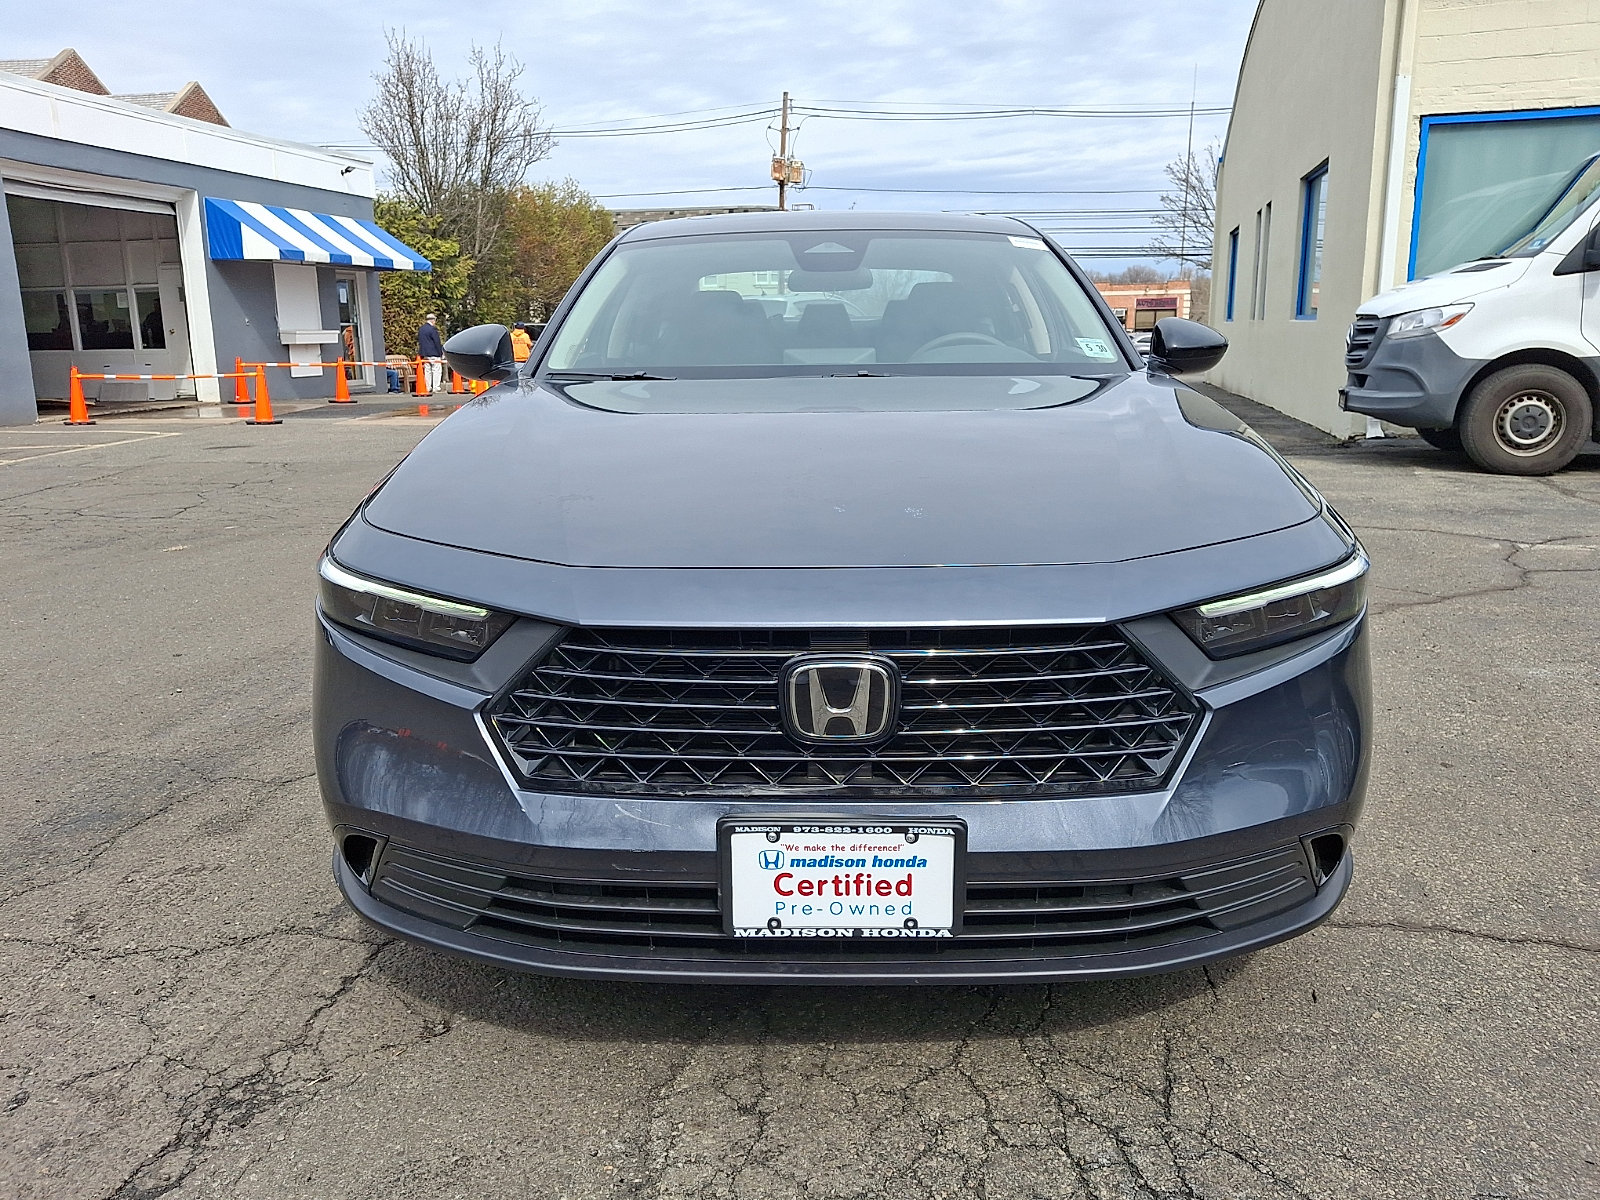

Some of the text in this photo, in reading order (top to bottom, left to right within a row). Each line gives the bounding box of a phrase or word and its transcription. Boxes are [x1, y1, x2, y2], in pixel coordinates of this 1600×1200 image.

[1085, 343, 1108, 353] 5 30
[792, 826, 893, 834] 973-822-1600
[908, 827, 956, 835] HONDA
[780, 843, 905, 852] "We make the difference!"
[789, 855, 867, 868] madison
[871, 855, 928, 868] honda
[773, 872, 913, 897] Certified
[775, 901, 912, 916] Pre-Owned
[733, 928, 954, 938] MADISON HONDA
